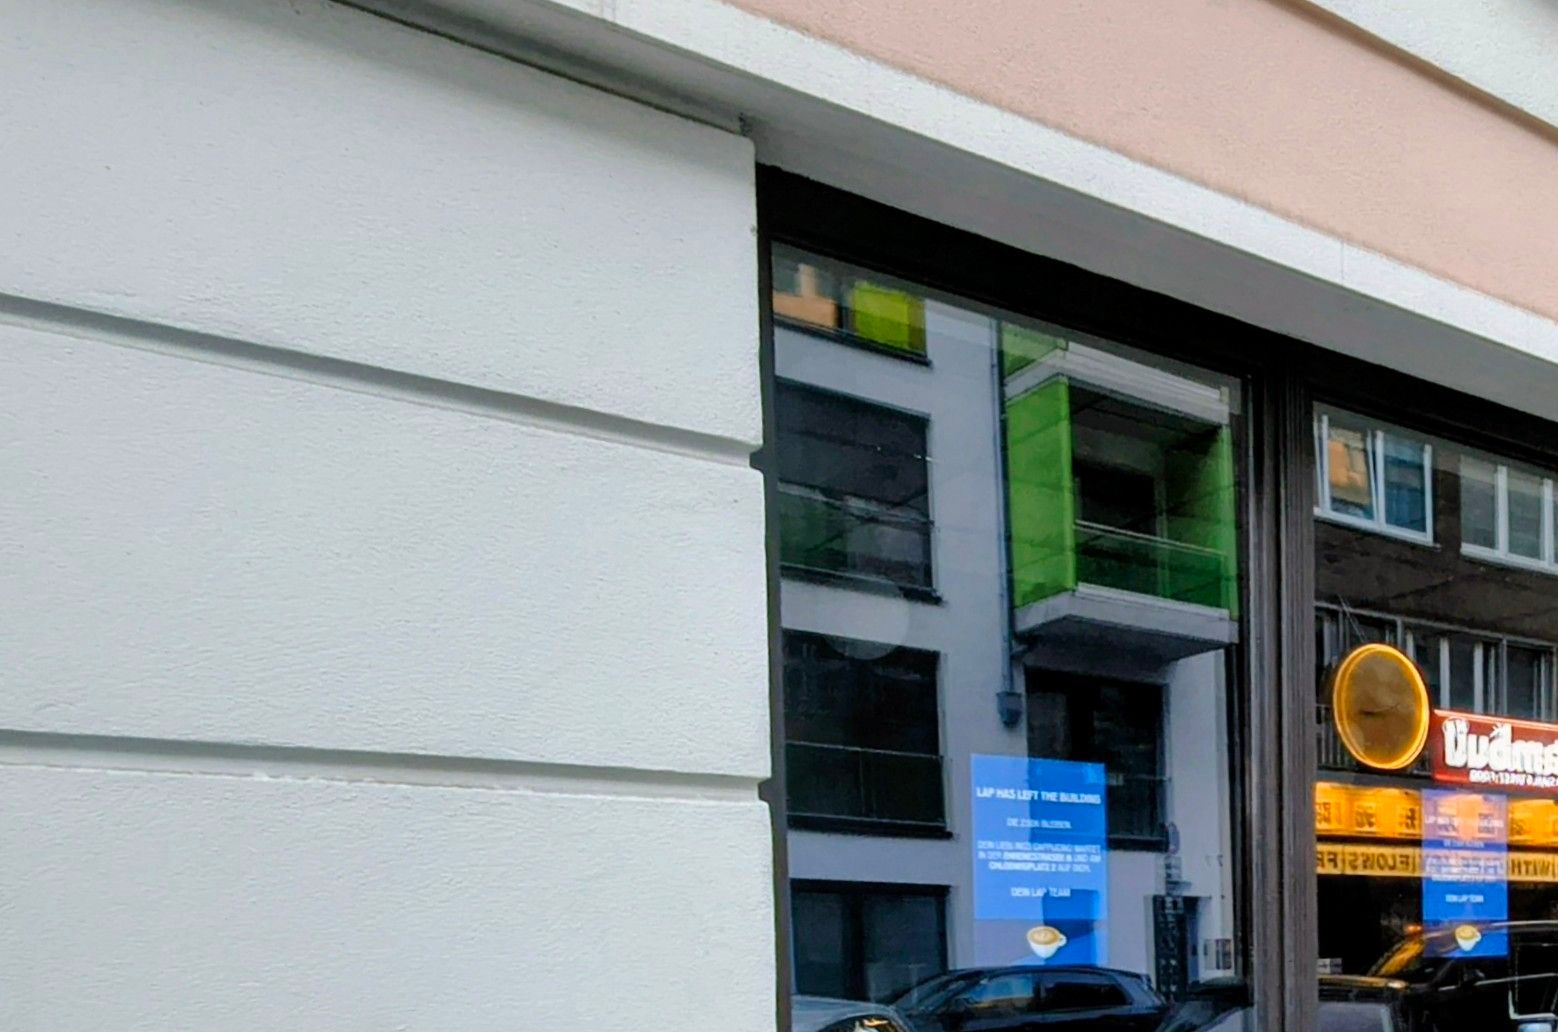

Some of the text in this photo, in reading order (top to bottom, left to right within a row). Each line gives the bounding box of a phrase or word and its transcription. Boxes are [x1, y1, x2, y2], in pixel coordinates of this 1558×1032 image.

[976, 787, 994, 798] LAP
[996, 788, 1016, 799] HAS
[1017, 789, 1038, 800] LEFT
[1040, 791, 1058, 802] THE
